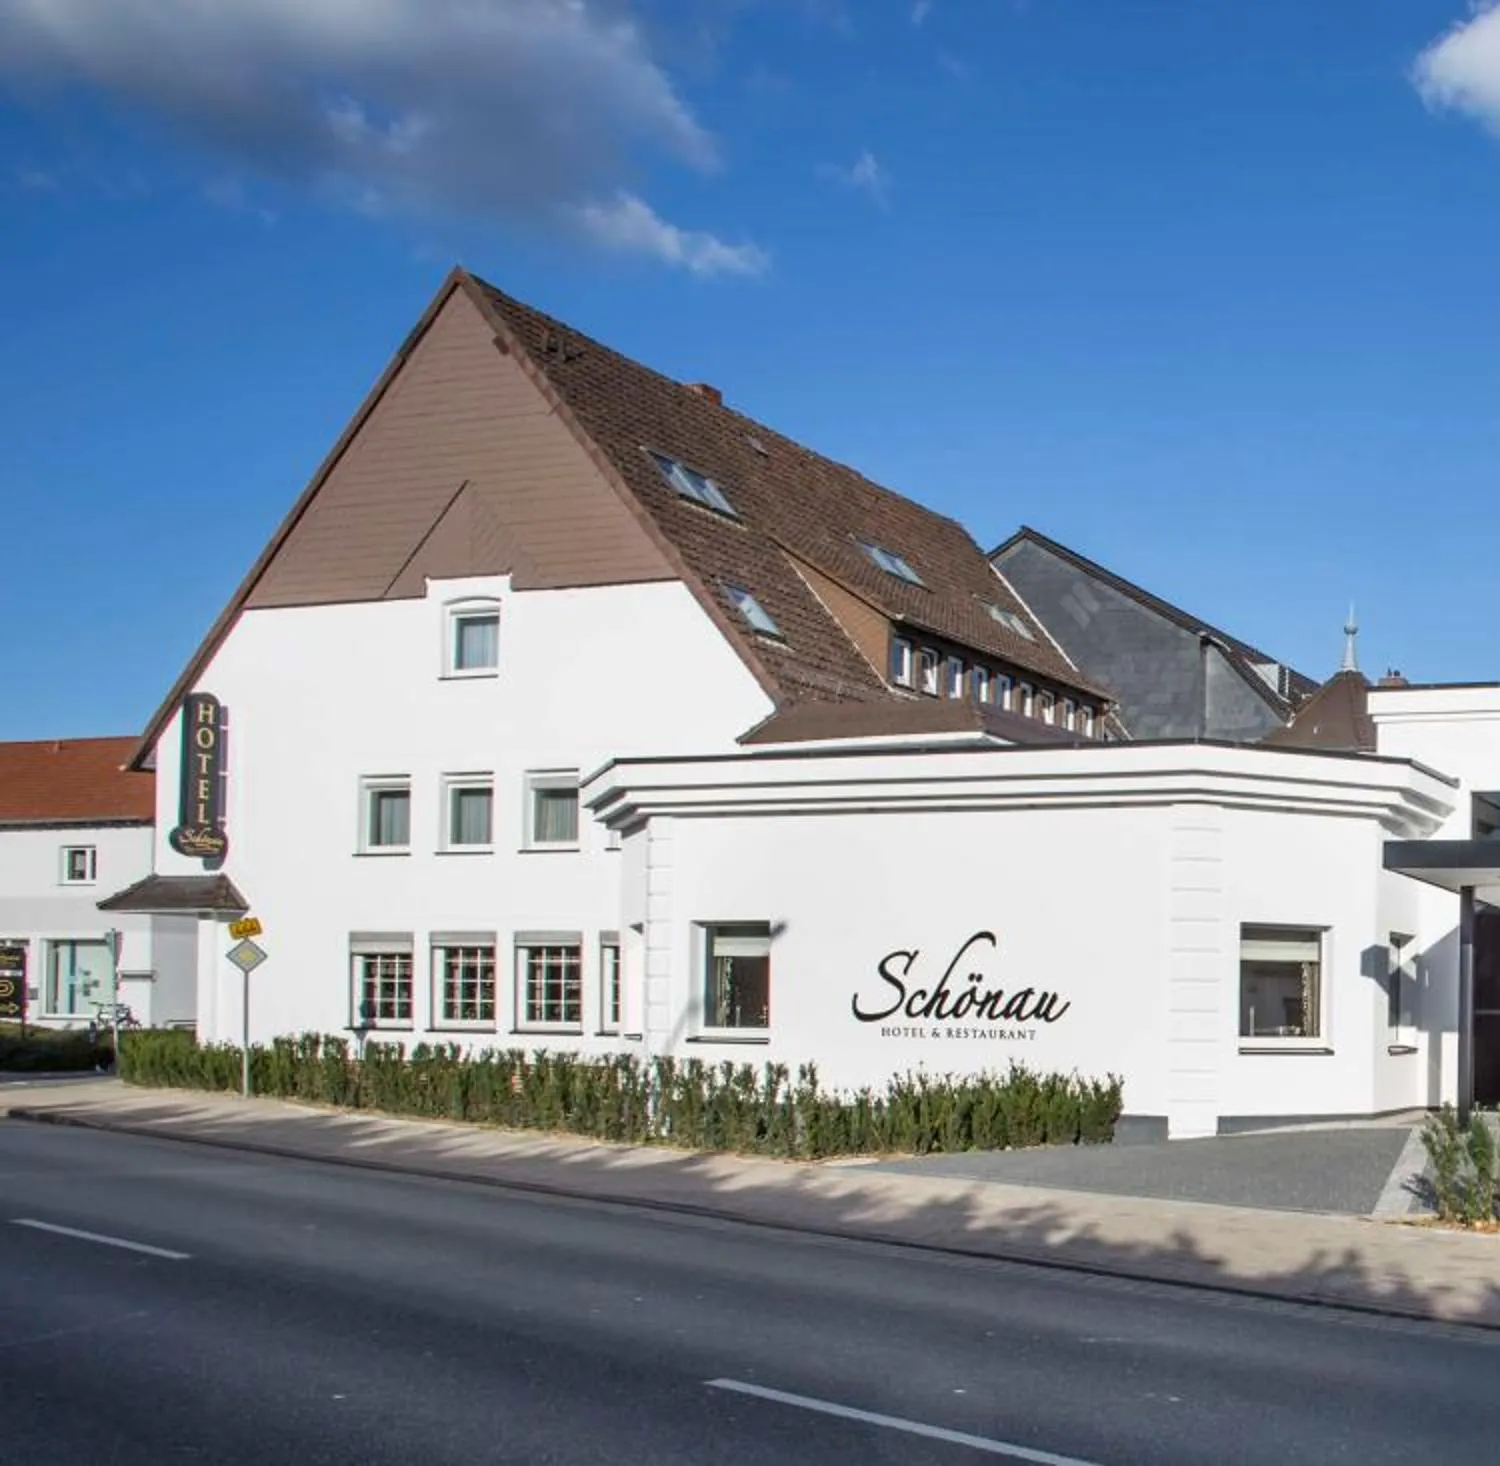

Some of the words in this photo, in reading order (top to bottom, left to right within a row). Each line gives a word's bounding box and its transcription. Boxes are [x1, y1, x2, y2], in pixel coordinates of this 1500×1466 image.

[196, 702, 215, 824] HOTEL
[852, 931, 1070, 1023] Schönau
[881, 1027, 925, 1038] HOTEL
[931, 1028, 941, 1038] &
[947, 1028, 1037, 1040] RESTAURANT
